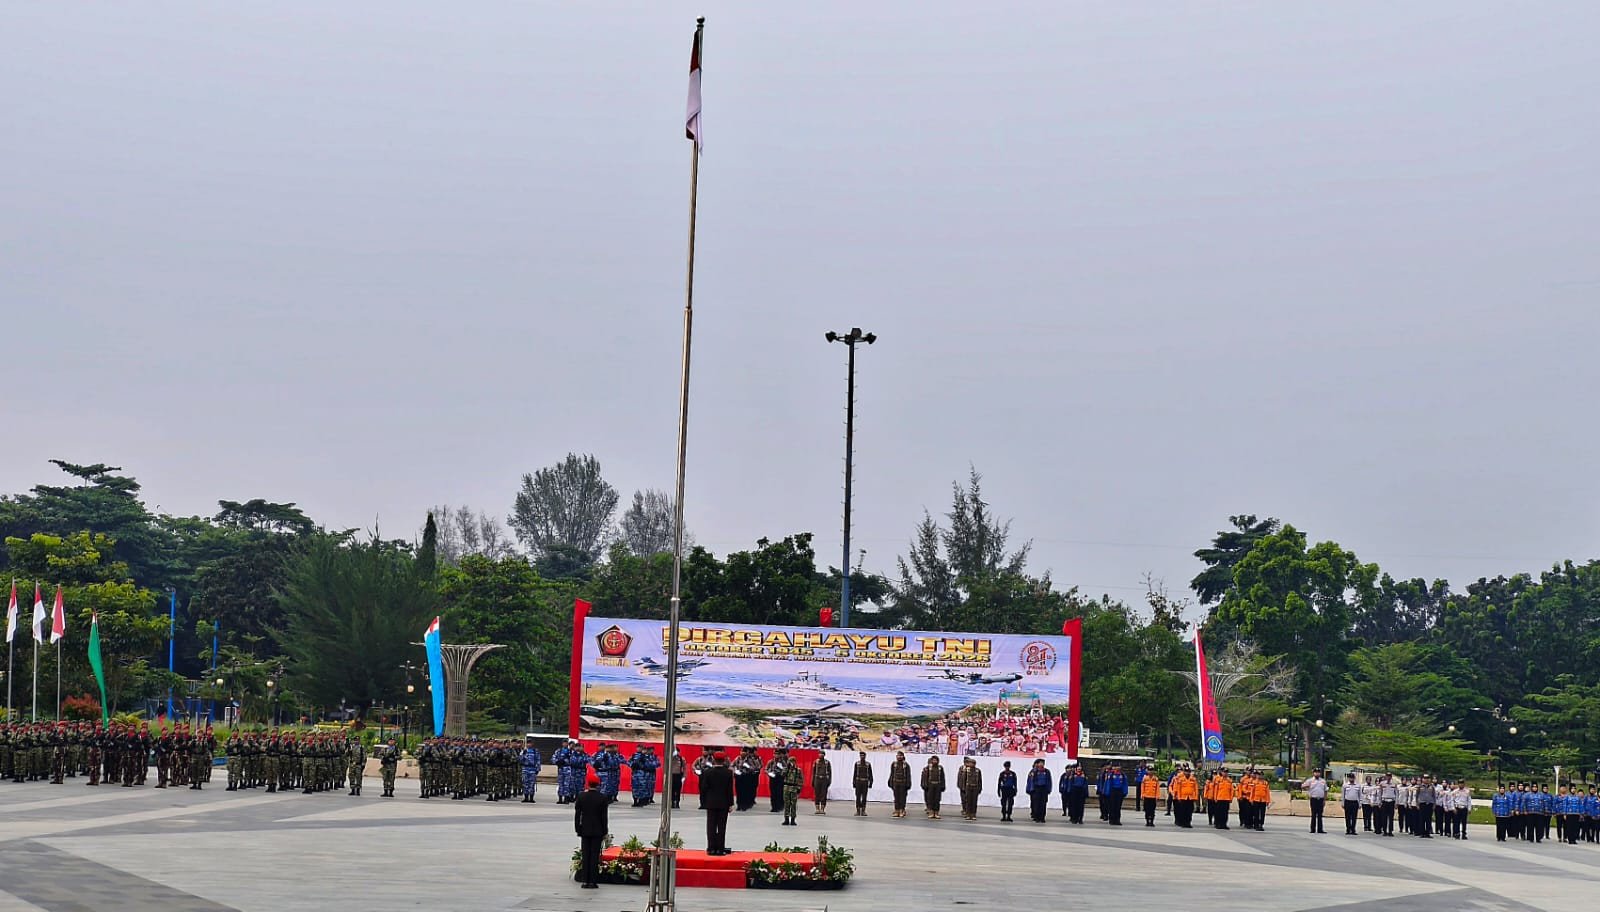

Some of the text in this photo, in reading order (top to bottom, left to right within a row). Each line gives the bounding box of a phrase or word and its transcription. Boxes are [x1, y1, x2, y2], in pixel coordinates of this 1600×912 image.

[662, 627, 992, 655] DIRGAHAYU TNI
[684, 643, 764, 655] OKTOBER
[766, 646, 815, 656] 1945
[834, 649, 850, 658] 5
[854, 650, 935, 661] OKTOBER
[937, 652, 992, 663] 2026
[794, 655, 845, 663] INDONESIA
[596, 657, 630, 667] PRIMA
